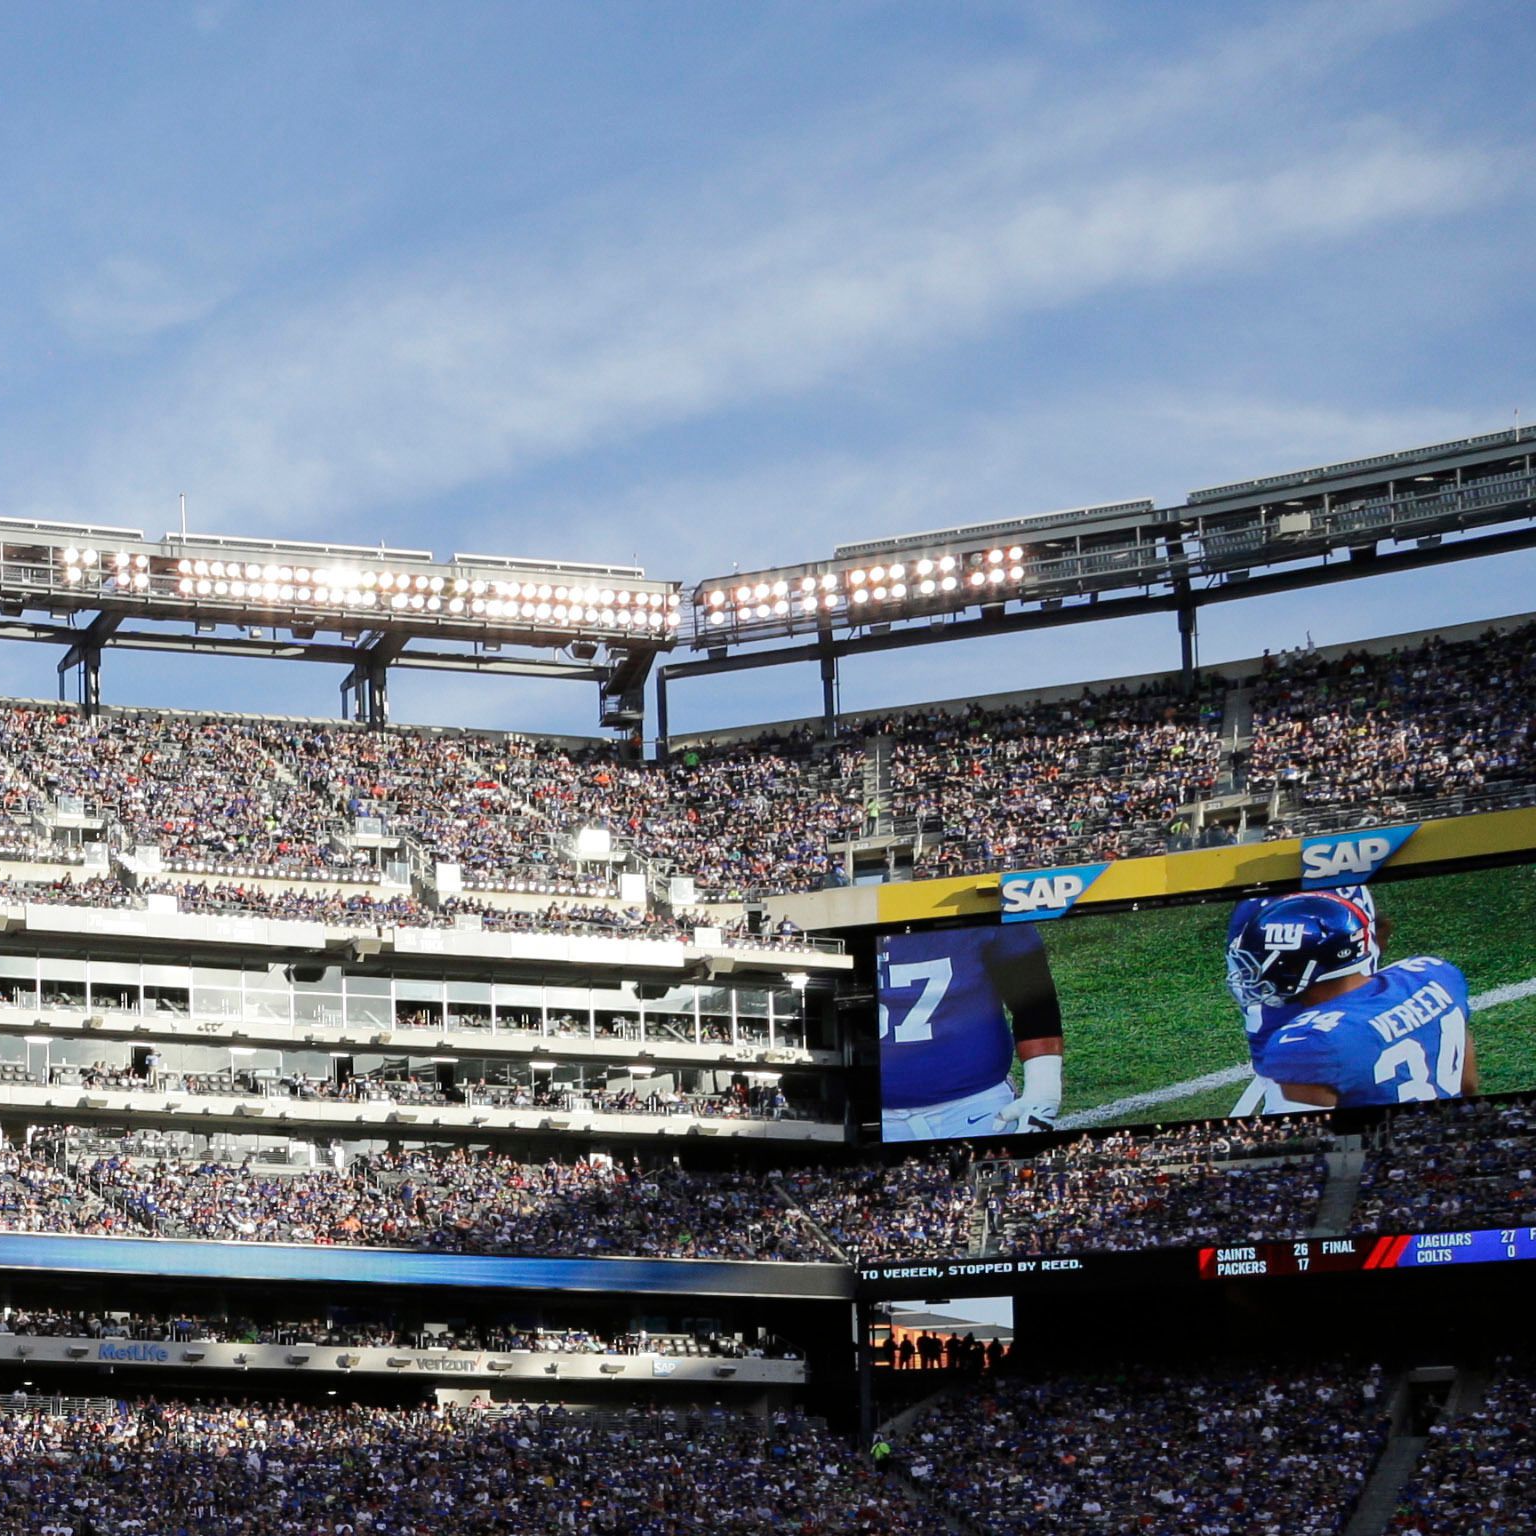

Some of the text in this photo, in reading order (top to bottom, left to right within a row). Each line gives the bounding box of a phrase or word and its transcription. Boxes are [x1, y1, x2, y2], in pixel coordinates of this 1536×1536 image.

[1303, 836, 1391, 881] SAP
[1002, 875, 1084, 914] SAP
[1260, 923, 1305, 950] ny
[1368, 980, 1454, 1043] VEREEN
[1373, 1006, 1467, 1104] 34
[1416, 1232, 1472, 1249] JAGUARS
[1500, 1229, 1516, 1244] 27
[1216, 1239, 1356, 1262] SAINTS 26 FINAL
[1417, 1244, 1516, 1264] COLTS 0
[860, 1259, 1084, 1280] TO VEREEN, STOPPED BY REED.
[1217, 1257, 1310, 1276] PACKERS 17
[98, 1342, 170, 1364] MetLife
[415, 1357, 477, 1374] verizon
[654, 1361, 677, 1374] SAP
